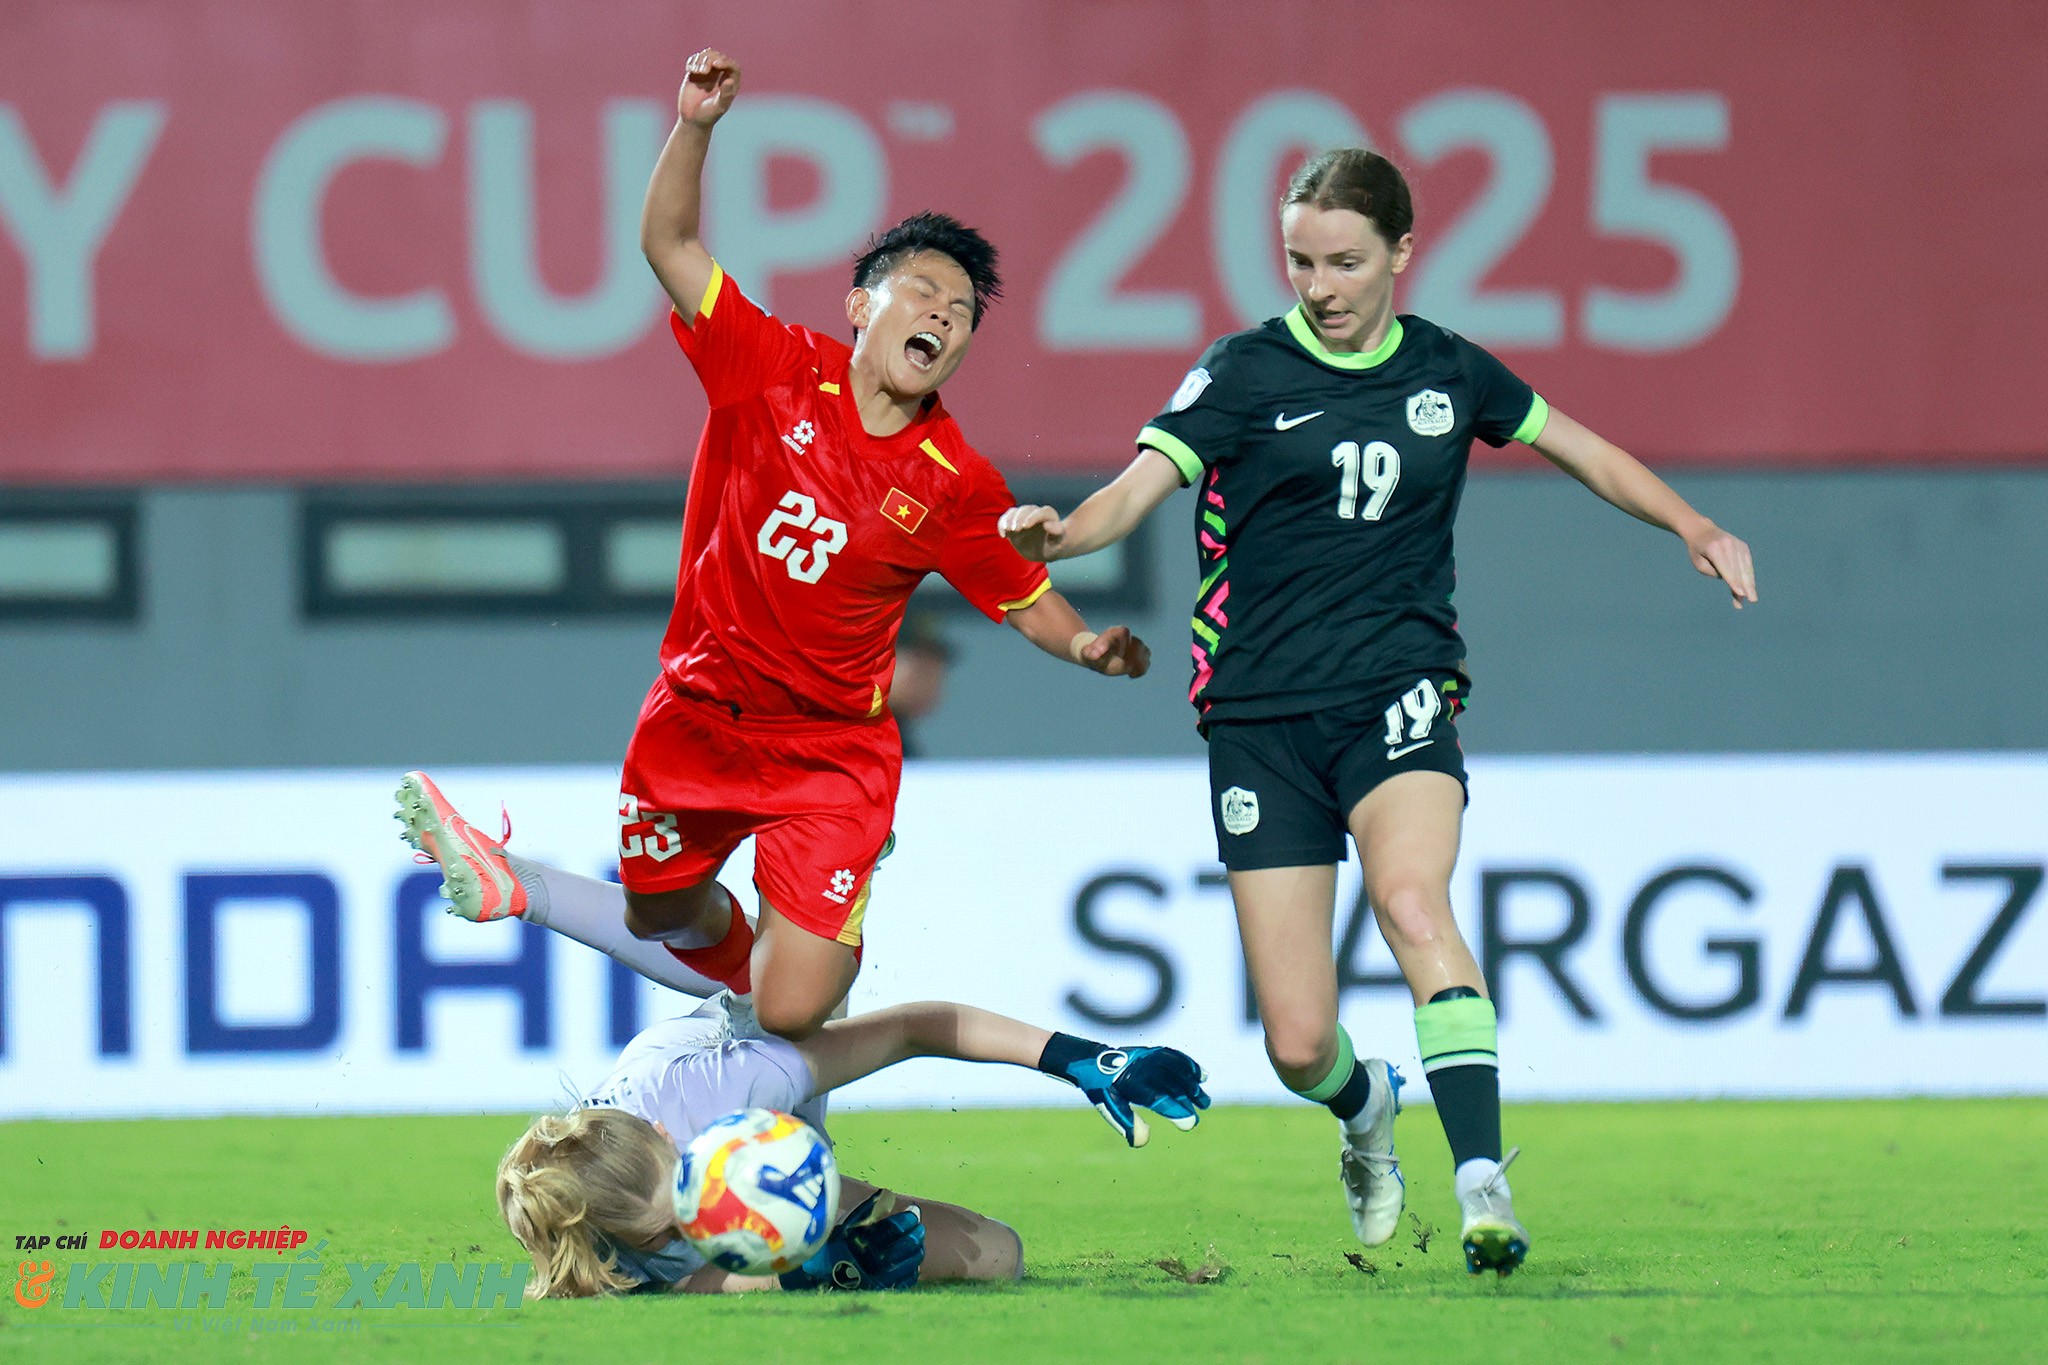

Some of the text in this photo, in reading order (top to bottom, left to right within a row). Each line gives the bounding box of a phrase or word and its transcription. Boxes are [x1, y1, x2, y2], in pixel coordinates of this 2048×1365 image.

[1031, 88, 1740, 354] 2025
[1331, 440, 1401, 521] 19
[757, 489, 848, 585] 23
[1384, 678, 1442, 746] 19
[618, 792, 683, 862] 23
